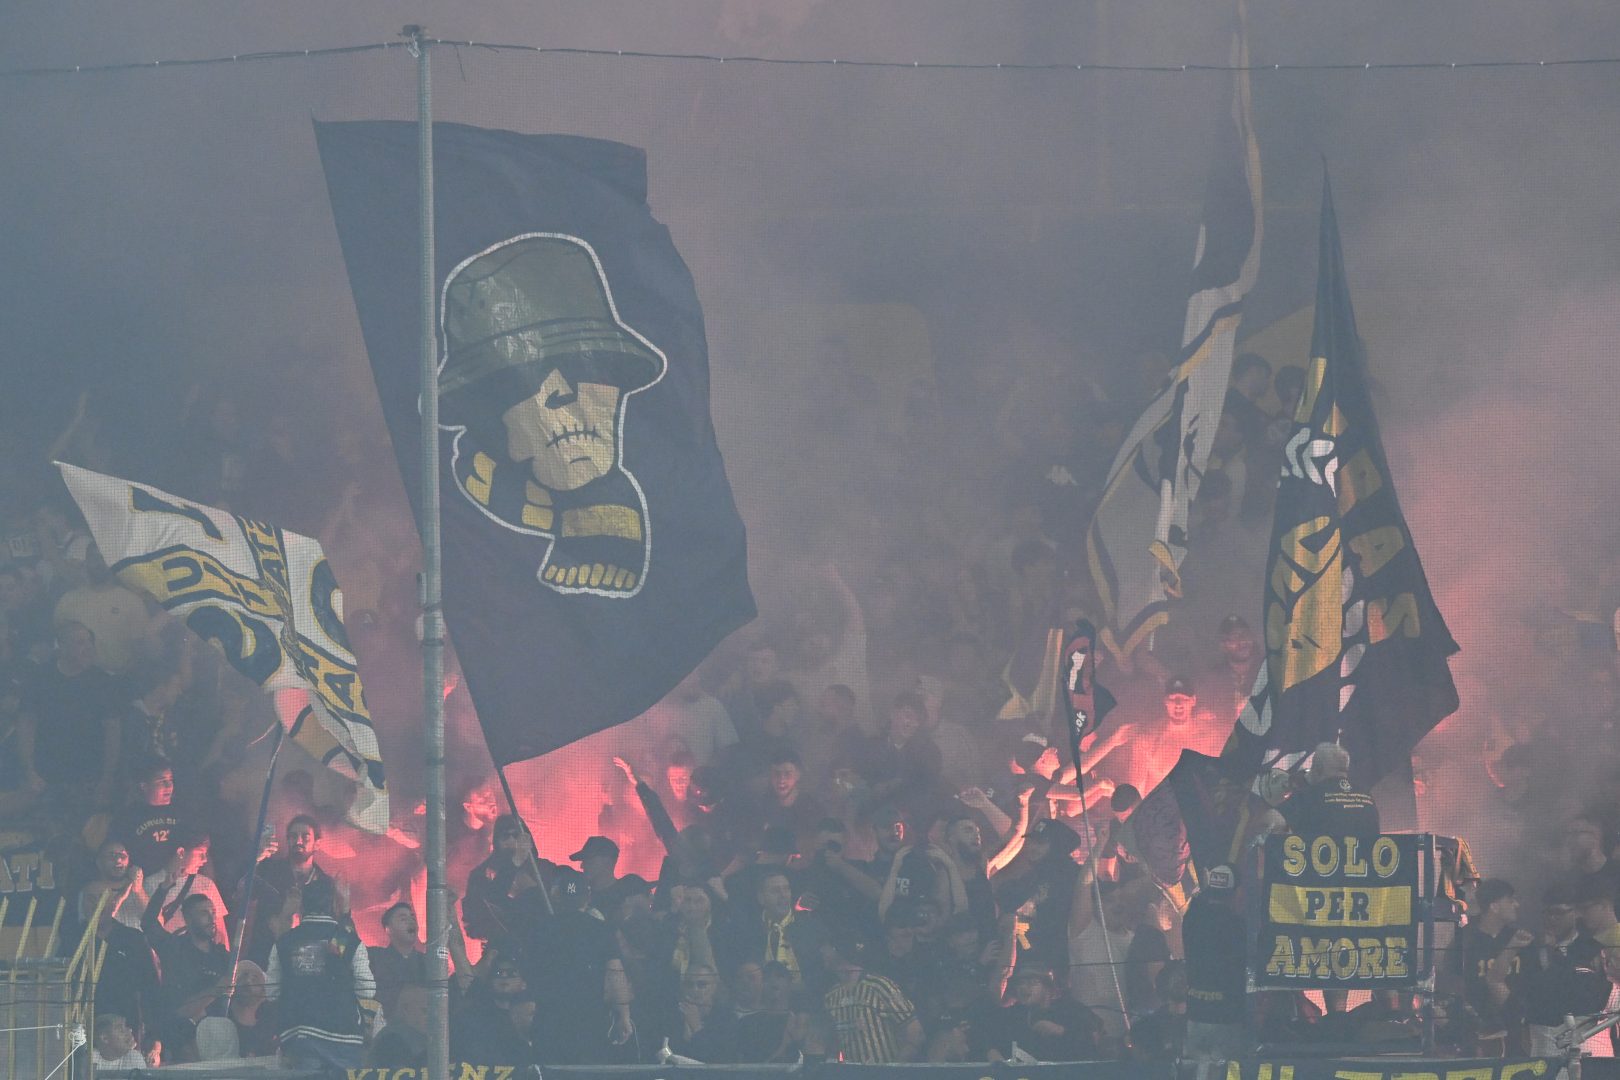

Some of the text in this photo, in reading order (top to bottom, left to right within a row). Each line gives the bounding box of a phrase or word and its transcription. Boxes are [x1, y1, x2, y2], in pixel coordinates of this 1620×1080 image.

[1283, 835, 1399, 878] SOLO
[1304, 890, 1370, 921] PER
[1266, 935, 1408, 980] AMORE
